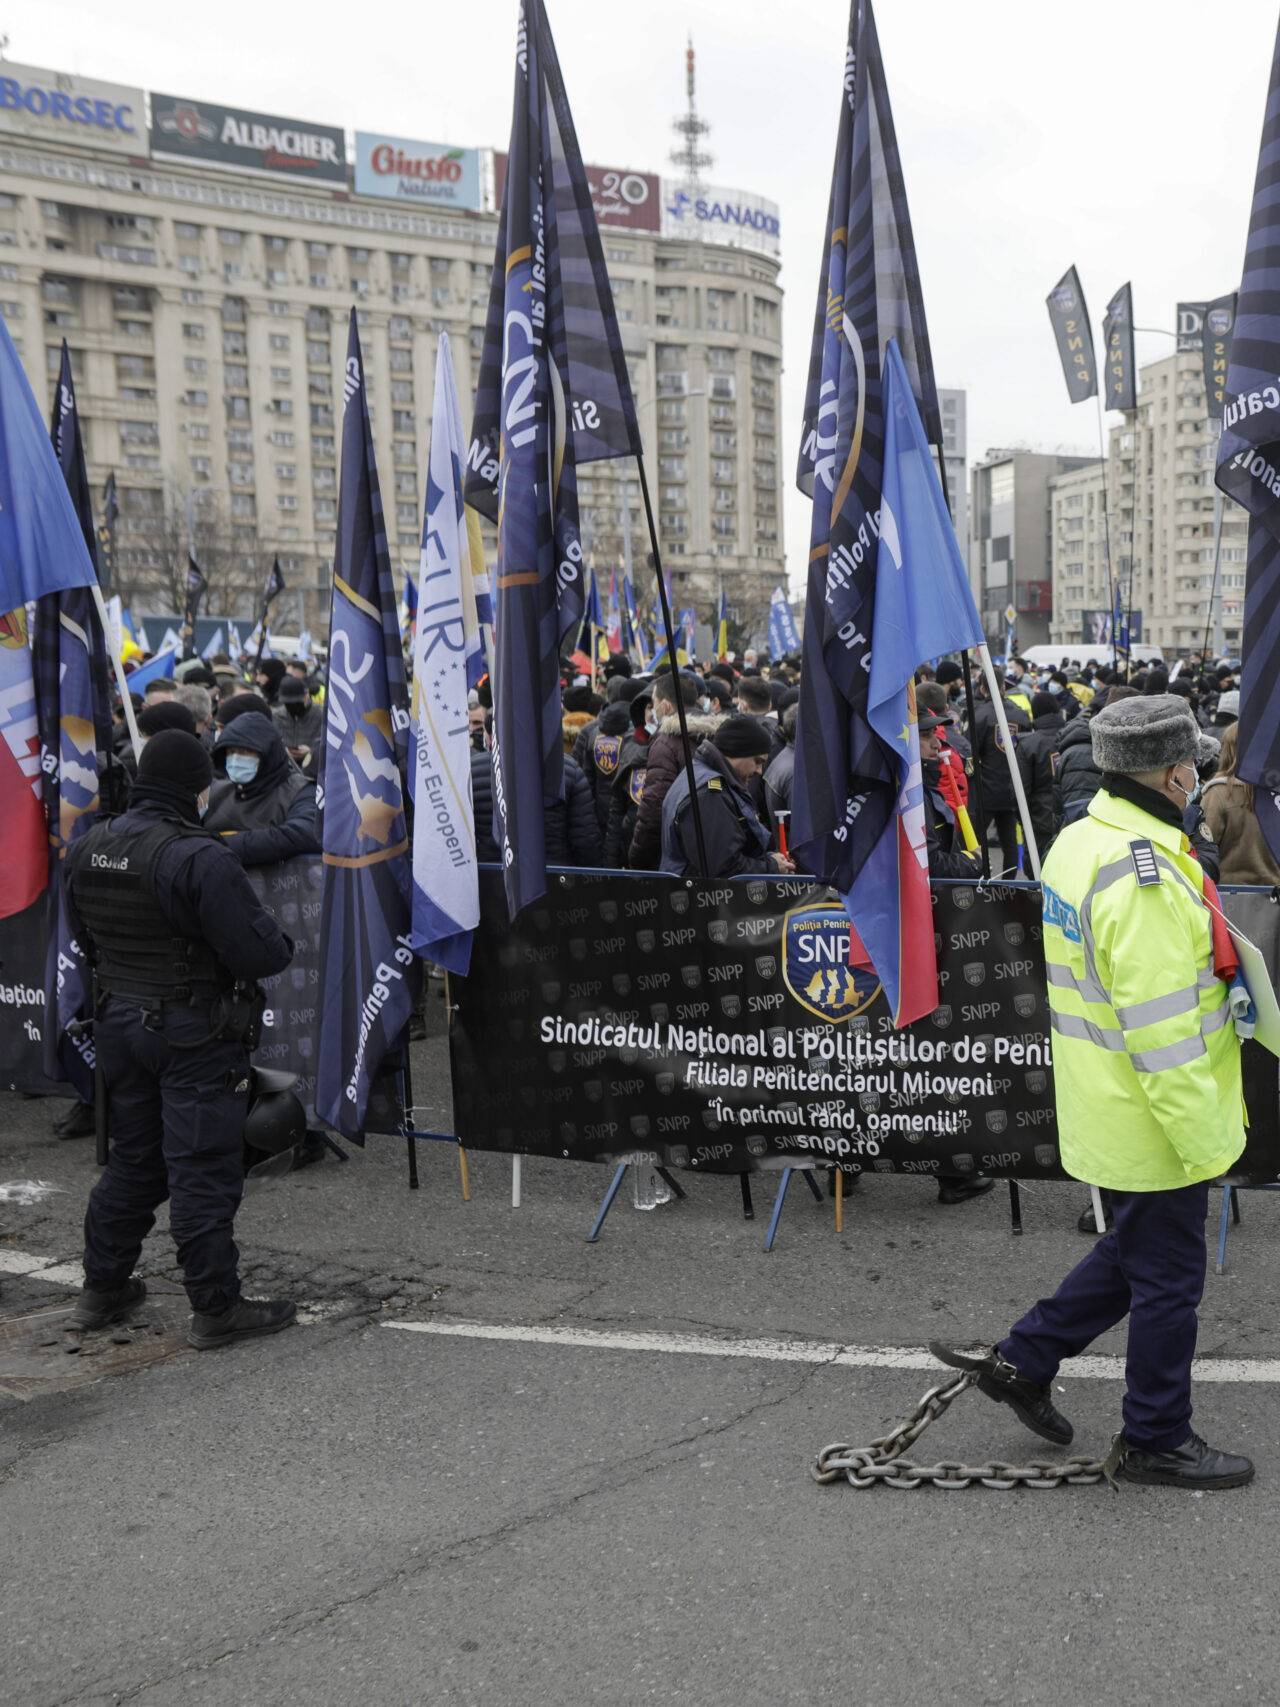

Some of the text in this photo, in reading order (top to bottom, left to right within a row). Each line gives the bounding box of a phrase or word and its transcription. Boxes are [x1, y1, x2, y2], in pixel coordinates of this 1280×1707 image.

[0, 76, 136, 133] BORSEC
[220, 115, 341, 166] ALBACHER
[371, 144, 462, 183] Giusto
[397, 178, 457, 200] Natura
[602, 171, 649, 206] 20
[694, 198, 781, 238] SANADOR
[424, 774, 471, 868] Europeni
[697, 889, 733, 908] SNPP
[951, 930, 990, 950] SNPP
[707, 964, 743, 983] SNPP
[994, 960, 1034, 979] SNPP
[748, 994, 785, 1012] SNPP
[962, 1002, 1001, 1021] SNPP
[540, 1015, 662, 1050] Sindicatul
[667, 1024, 768, 1058] Național
[772, 1029, 797, 1059] al
[803, 1031, 947, 1066] Polițiștilor
[953, 1035, 987, 1063] de
[686, 1061, 995, 1097] Filiala Penitenciarul Mioveni
[740, 1105, 805, 1127] primul
[811, 1107, 862, 1131] rând,
[797, 1135, 881, 1157] snpp.ro
[982, 1152, 1022, 1169] SNPP
